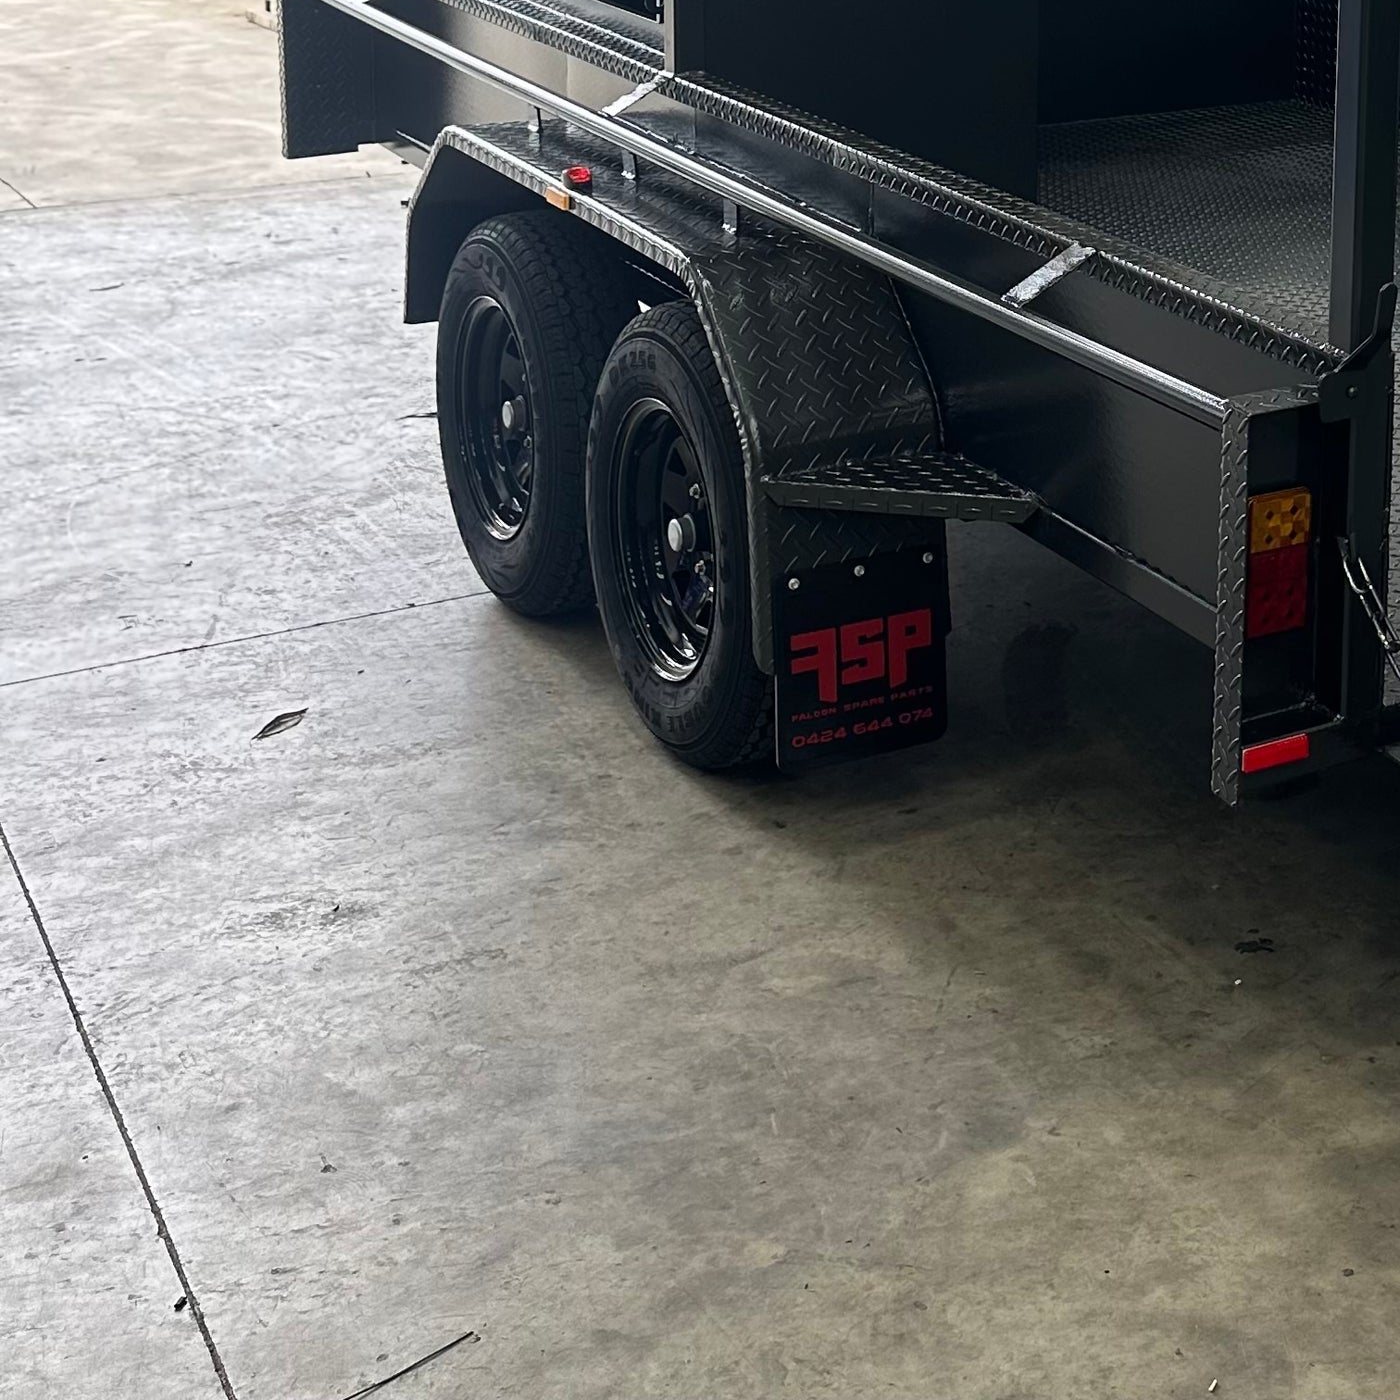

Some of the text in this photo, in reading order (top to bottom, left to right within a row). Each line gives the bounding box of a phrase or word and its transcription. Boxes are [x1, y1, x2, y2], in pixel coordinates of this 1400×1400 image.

[791, 686, 933, 722] FALCON SPARE PARTS
[791, 707, 933, 748] 0424 644 074
